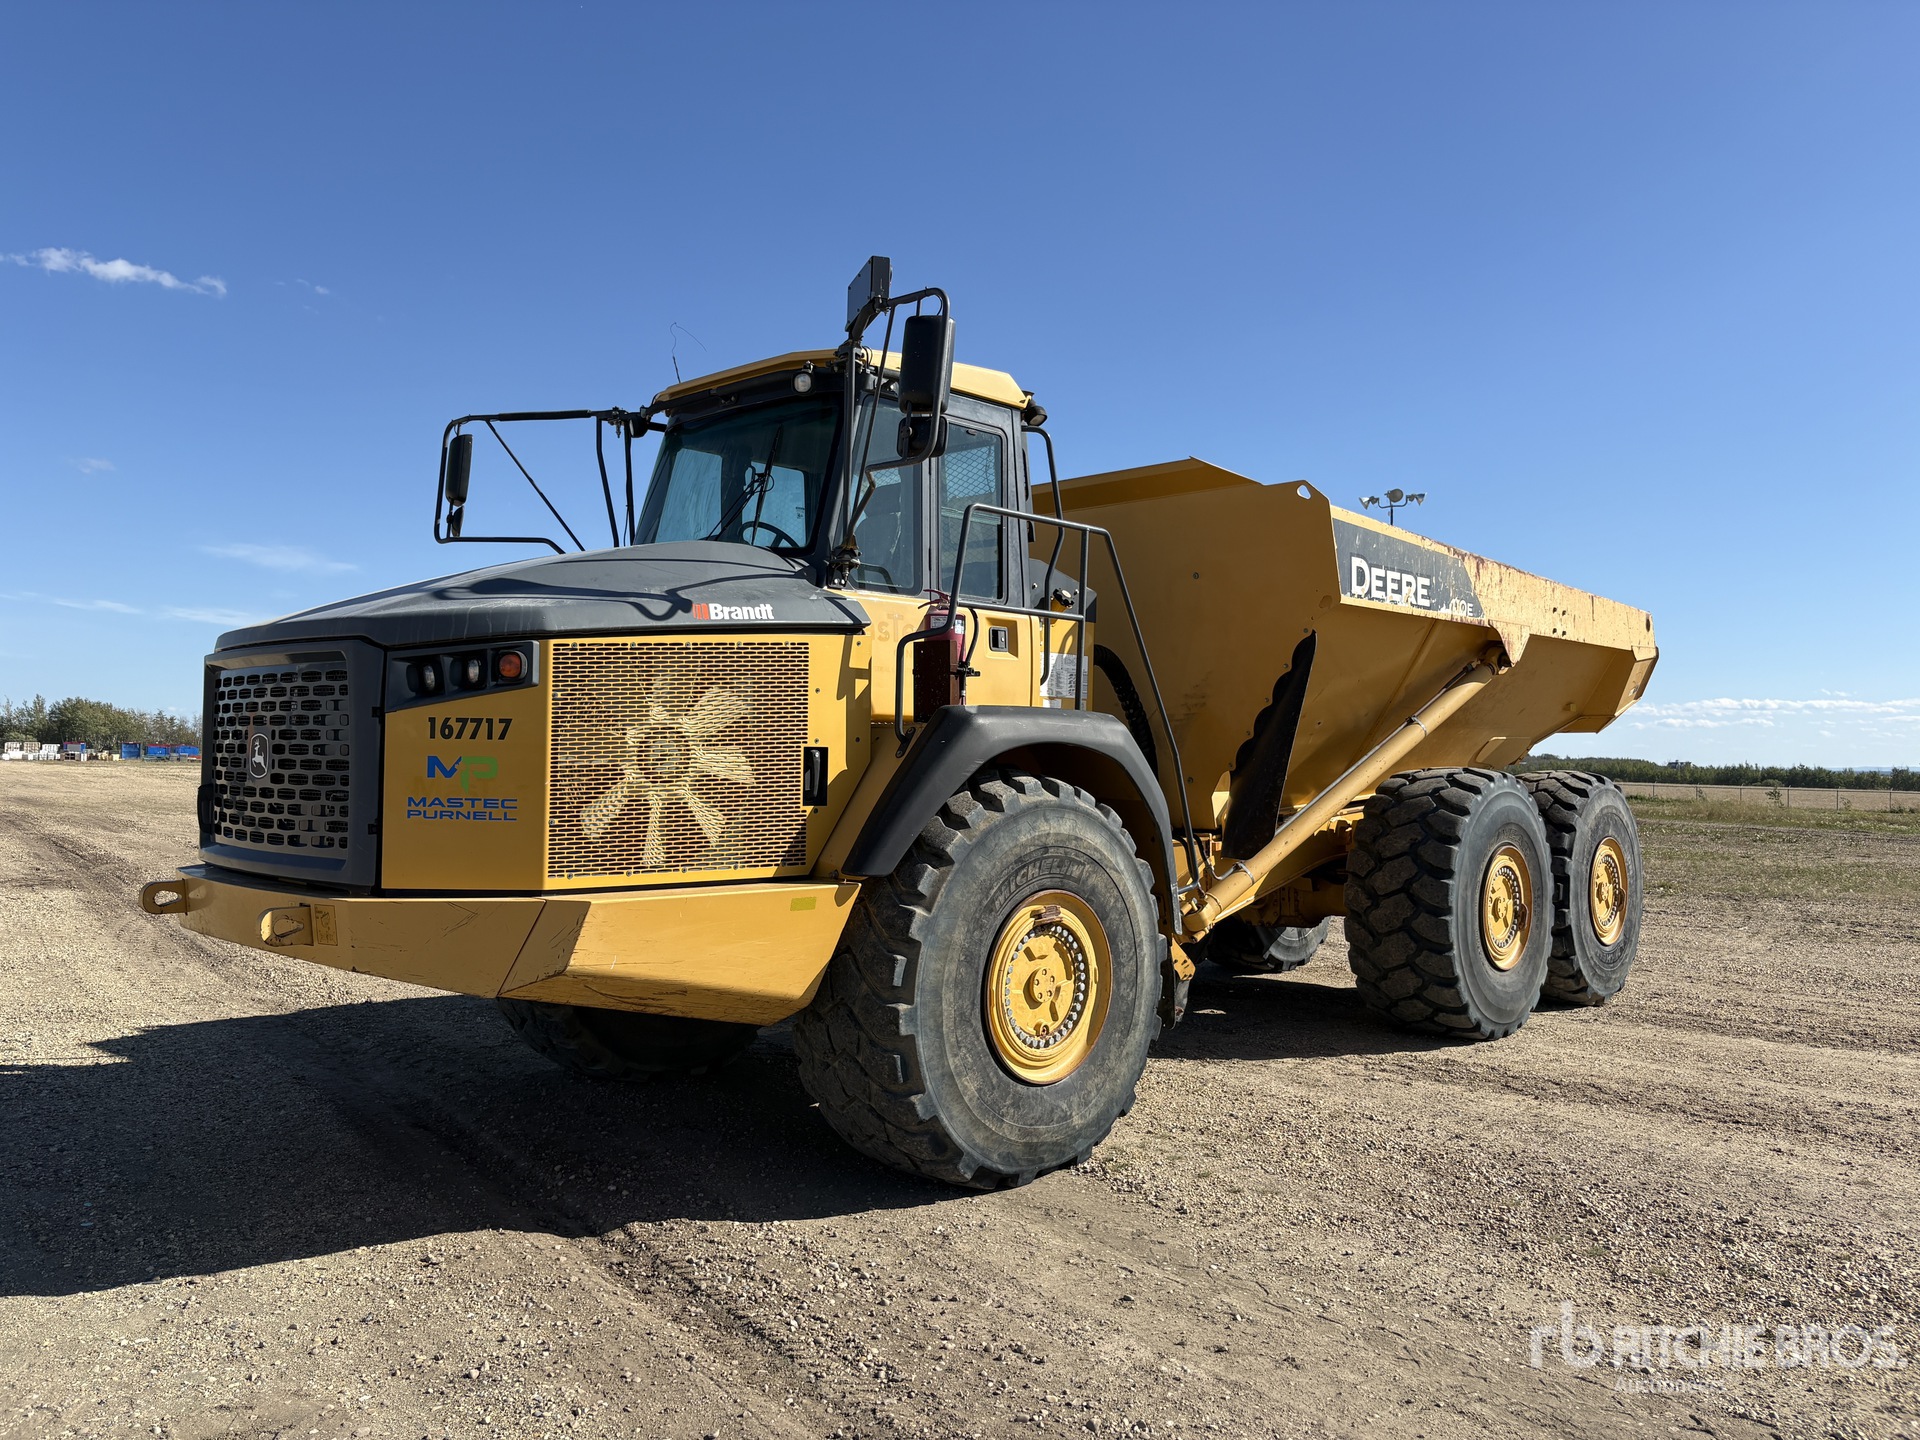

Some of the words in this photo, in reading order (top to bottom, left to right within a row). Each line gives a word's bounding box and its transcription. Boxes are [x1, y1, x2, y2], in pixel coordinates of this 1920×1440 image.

[1350, 556, 1431, 608] DEERE
[709, 603, 774, 620] Brandt
[428, 716, 513, 741] 167717
[407, 796, 518, 810] MASTEC
[407, 809, 517, 822] PURNELL
